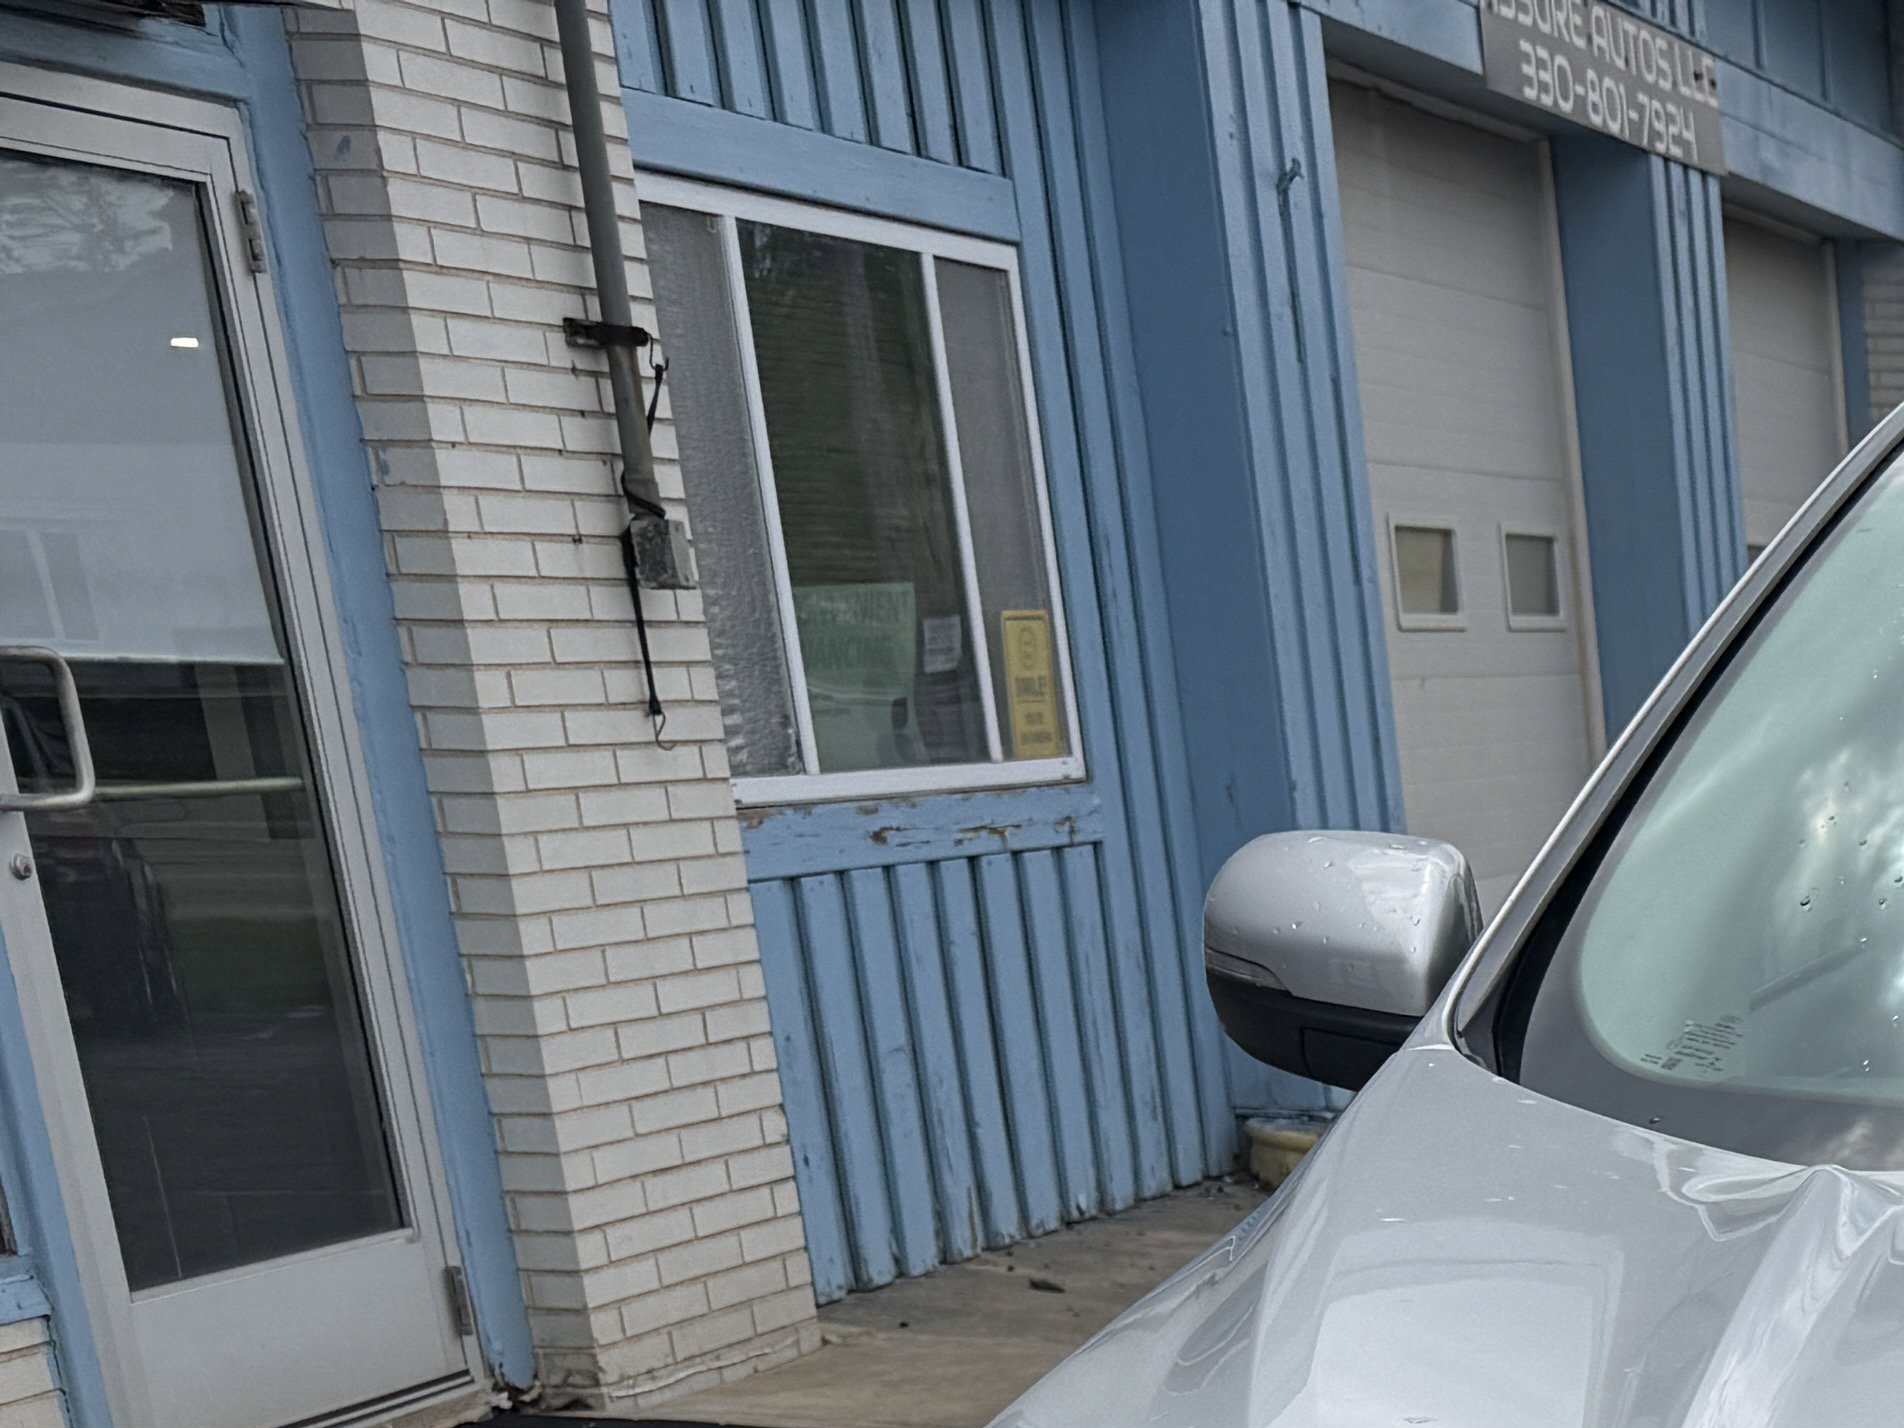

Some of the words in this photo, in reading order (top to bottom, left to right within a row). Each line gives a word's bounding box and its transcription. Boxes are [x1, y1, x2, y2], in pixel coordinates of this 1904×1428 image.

[1480, 0, 1587, 49] SURE
[1590, 4, 1673, 92] AUTOS
[1674, 42, 1719, 109] LLC
[1519, 38, 1699, 164] 330-801-7924
